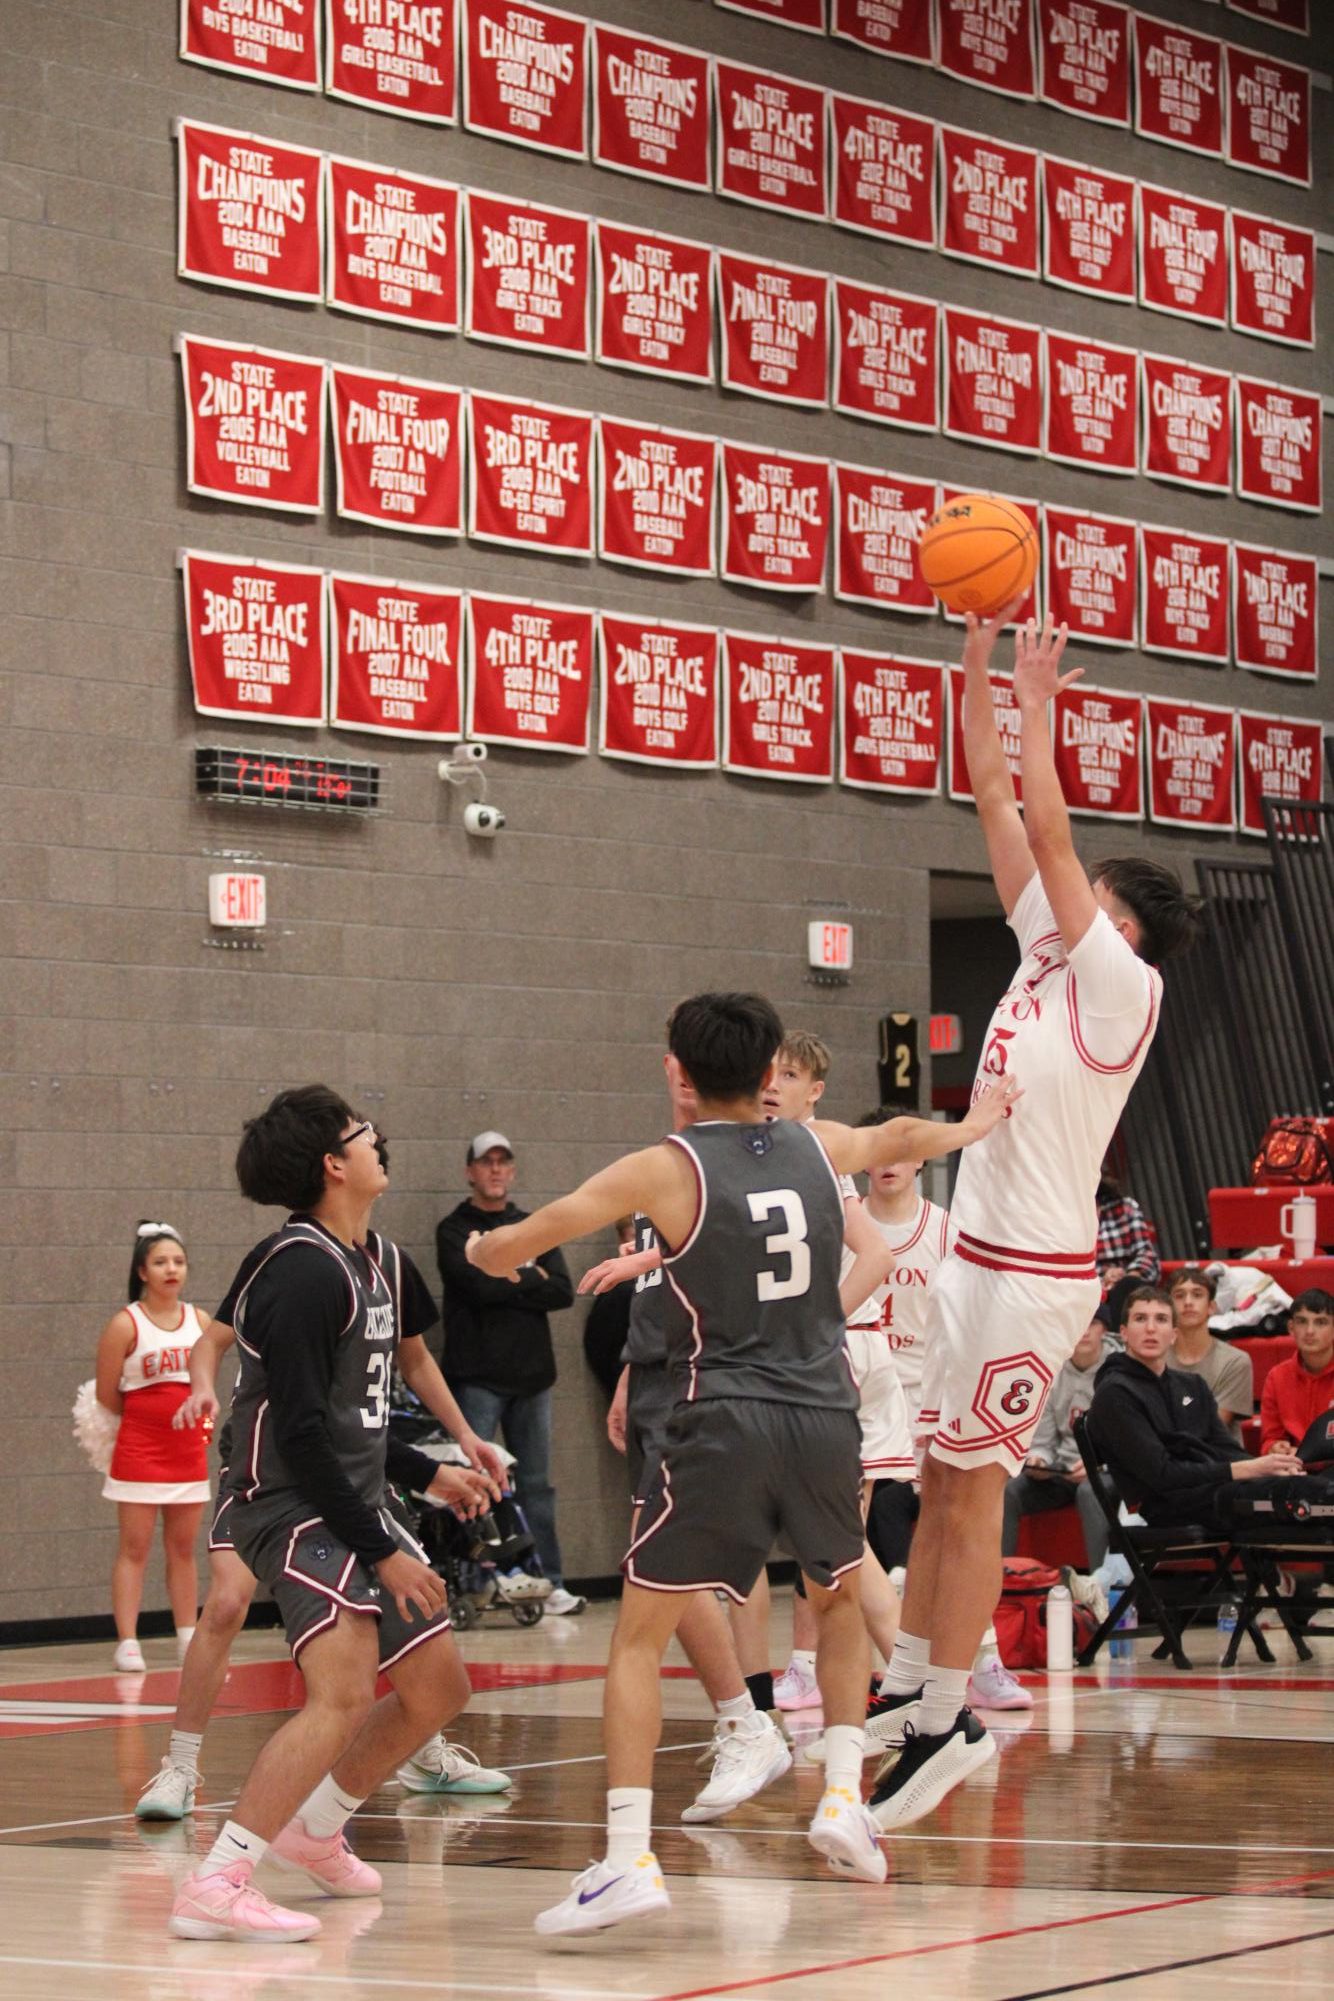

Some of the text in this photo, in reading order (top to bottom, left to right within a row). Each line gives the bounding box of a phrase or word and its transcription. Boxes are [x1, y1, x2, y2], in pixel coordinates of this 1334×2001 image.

[257, 2, 284, 26] AAA
[344, 0, 442, 47] 4TH PLACE
[507, 11, 545, 40] STATE
[203, 6, 304, 52] BOYS BASKETBALL
[234, 39, 267, 63] EATON
[398, 33, 423, 60] AAA
[479, 15, 573, 84] CHAMPIONS
[342, 44, 443, 85] GIRLS BASKETBALL
[634, 49, 670, 76] STATE
[378, 74, 409, 96] EATON
[530, 68, 555, 96] AAA
[608, 55, 697, 117] CHAMPIONS
[755, 84, 788, 109] STATE
[500, 84, 552, 116] BASEBALL
[510, 107, 540, 130] EATON
[732, 91, 813, 150] 2ND PLACE
[867, 115, 899, 140] STATE
[230, 147, 272, 176] STATE
[844, 126, 923, 181] 4TH PLACE
[198, 154, 304, 222] CHAMPIONS
[375, 183, 415, 211] STATE
[953, 156, 1028, 213] 2ND PLACE
[218, 201, 284, 236] 2004 AAA
[346, 190, 446, 255] CHAMPIONS
[1056, 188, 1125, 236] 4TH PLACE
[223, 226, 280, 257] BASEBALL
[508, 215, 547, 241] STATE
[234, 251, 268, 274] EATON
[365, 236, 427, 270] 2007 AAA
[482, 225, 574, 285] 3RD PLACE
[636, 244, 672, 270] STATE
[348, 254, 443, 295] BOYS BASKETBALL
[533, 271, 558, 298] AAA
[609, 253, 699, 311] 2ND PLACE
[756, 273, 790, 297] STATE
[380, 283, 411, 306] EATON
[496, 289, 562, 318] GIRLS TRACK
[730, 281, 816, 337] FINAL FOUR
[514, 313, 544, 334] EATON
[870, 301, 902, 325] STATE
[848, 308, 927, 366] 2ND PLACE
[232, 361, 274, 388] STATE
[956, 336, 1032, 388] FINAL FOUR
[198, 372, 307, 434] 2ND PLACE
[378, 390, 418, 416] STATE
[1153, 380, 1222, 430] CHAMPIONS
[220, 416, 287, 449] 2005 AAA
[346, 400, 449, 458] FINAL FOUR
[512, 414, 550, 440] STATE
[1248, 401, 1312, 451] CHAMPIONS
[216, 440, 290, 471] VOLLEYBALL
[373, 445, 425, 474] 2007 AA
[485, 425, 580, 483] 3RD PLACE
[640, 440, 676, 465] STATE
[236, 465, 270, 488] EATON
[370, 468, 426, 496] FOOTBALL
[535, 470, 562, 497] AAA
[613, 449, 704, 507] 2ND PLACE
[759, 463, 792, 486] STATE
[382, 491, 414, 513] EATON
[500, 488, 566, 518] CO-ED SPIRIT
[736, 474, 821, 525] 3RD PLACE
[870, 486, 904, 508] STATE
[518, 512, 546, 534] EATON
[1056, 531, 1127, 581] CHAMPIONS
[233, 576, 276, 602] STATE
[1154, 556, 1220, 599] 4TH PLACE
[201, 589, 308, 647] 3RD PLACE
[378, 597, 418, 622] STATE
[347, 609, 451, 665] FINAL FOUR
[512, 614, 552, 639] STATE
[223, 633, 289, 663] 2005 AAA
[485, 628, 581, 680] 4TH PLACE
[641, 633, 678, 656] STATE
[224, 658, 290, 684] WRESTLING
[368, 652, 429, 680] 2007 AAA
[615, 644, 706, 696] 2ND PLACE
[763, 651, 797, 674] STATE
[238, 682, 272, 703] EATON
[370, 676, 427, 702] BASEBALL
[535, 670, 559, 695] AAA
[739, 662, 823, 713] 2ND PLACE
[875, 668, 907, 690] STATE
[382, 699, 414, 720] EATON
[505, 689, 560, 715] BOYS GOLF
[854, 682, 932, 728] 4TH PLACE
[518, 712, 547, 733] EATON
[1063, 708, 1135, 756] CHAMPIONS
[1157, 724, 1226, 767] CHAMPIONS
[226, 877, 260, 920] EXIT
[824, 924, 849, 964] EXIT
[895, 1044, 911, 1088] 2
[746, 1189, 811, 1302] 3
